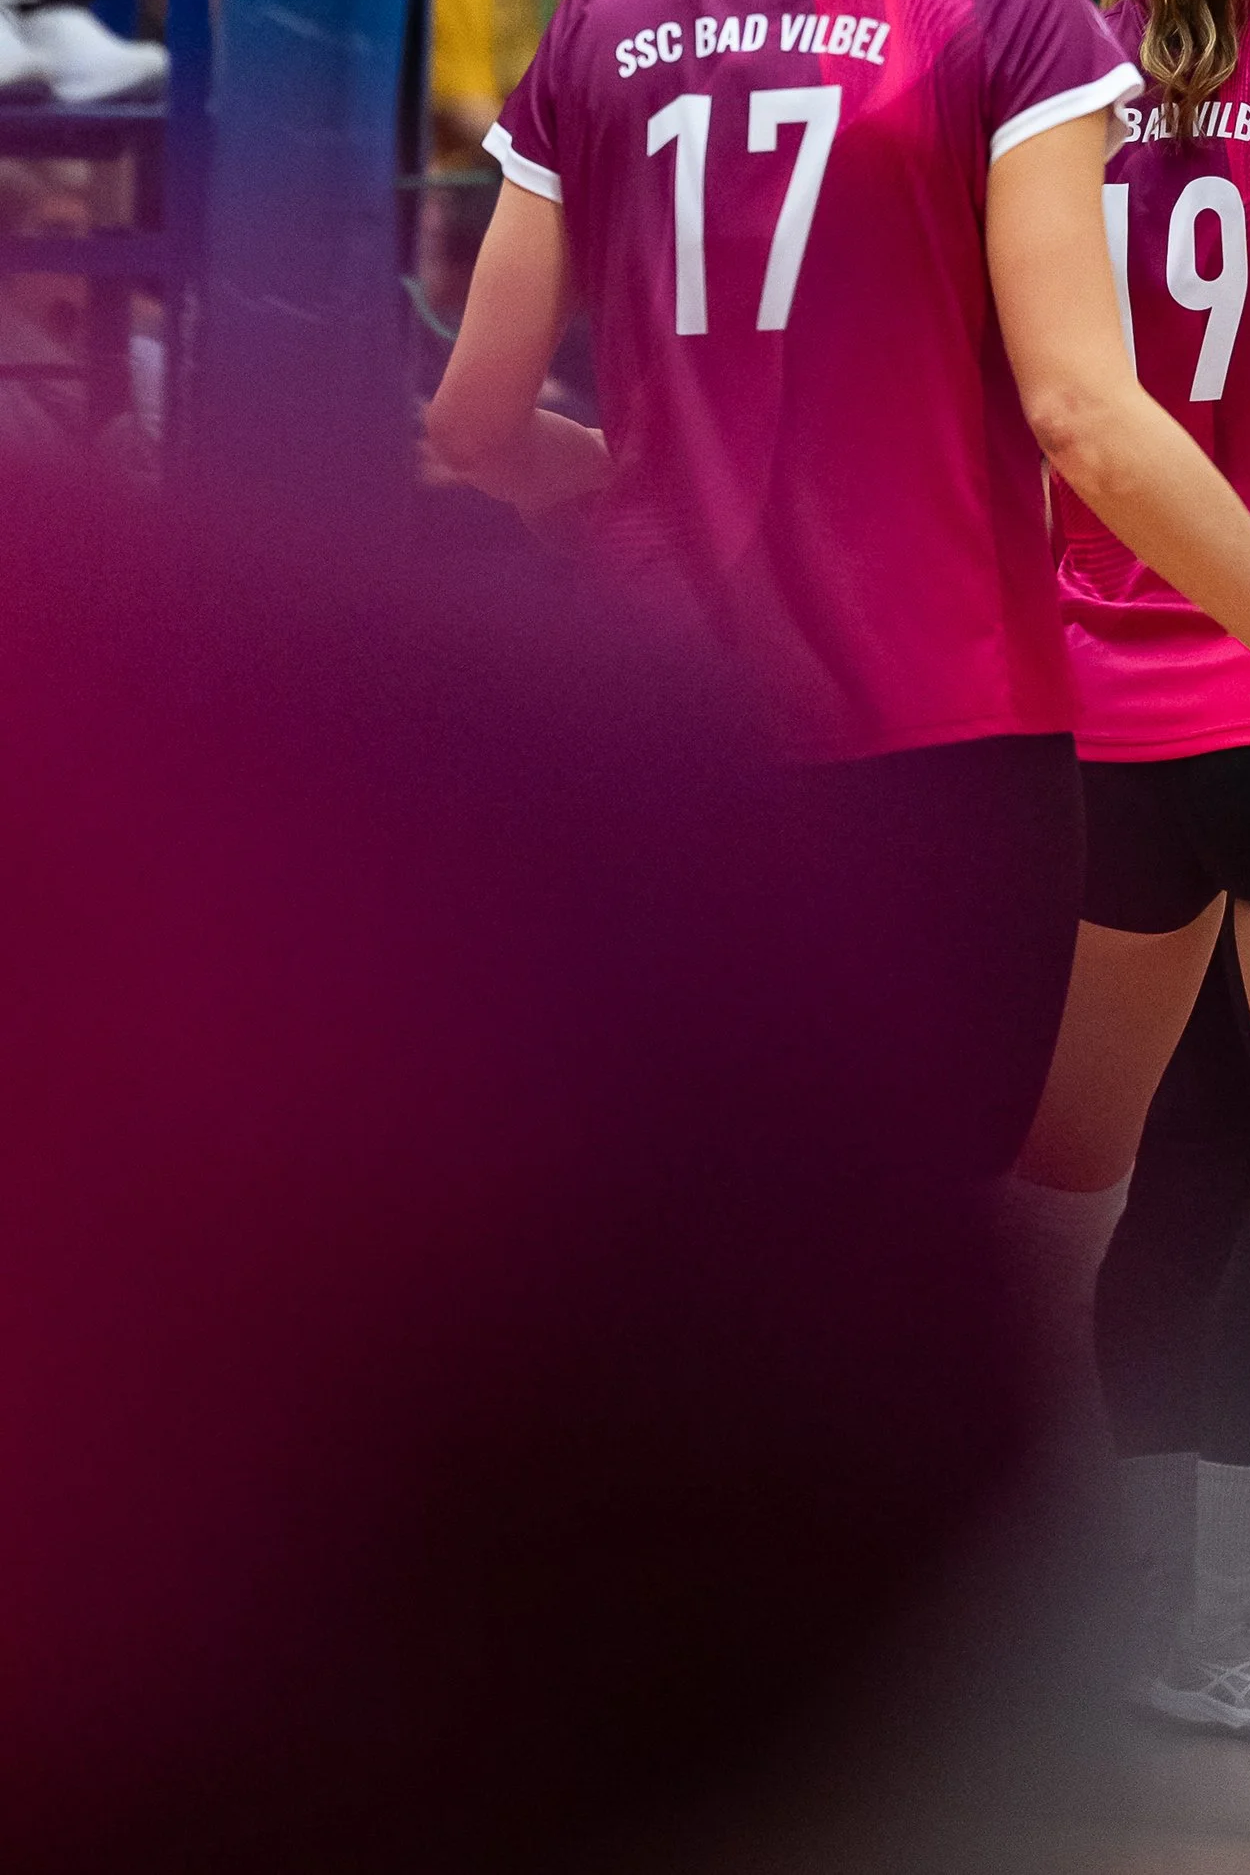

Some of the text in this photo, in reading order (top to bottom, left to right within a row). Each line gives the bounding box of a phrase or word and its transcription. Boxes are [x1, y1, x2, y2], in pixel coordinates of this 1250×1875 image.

[615, 13, 891, 78] SSC BAD VILBEL
[1124, 102, 1178, 143] BAD
[647, 84, 842, 335] 17
